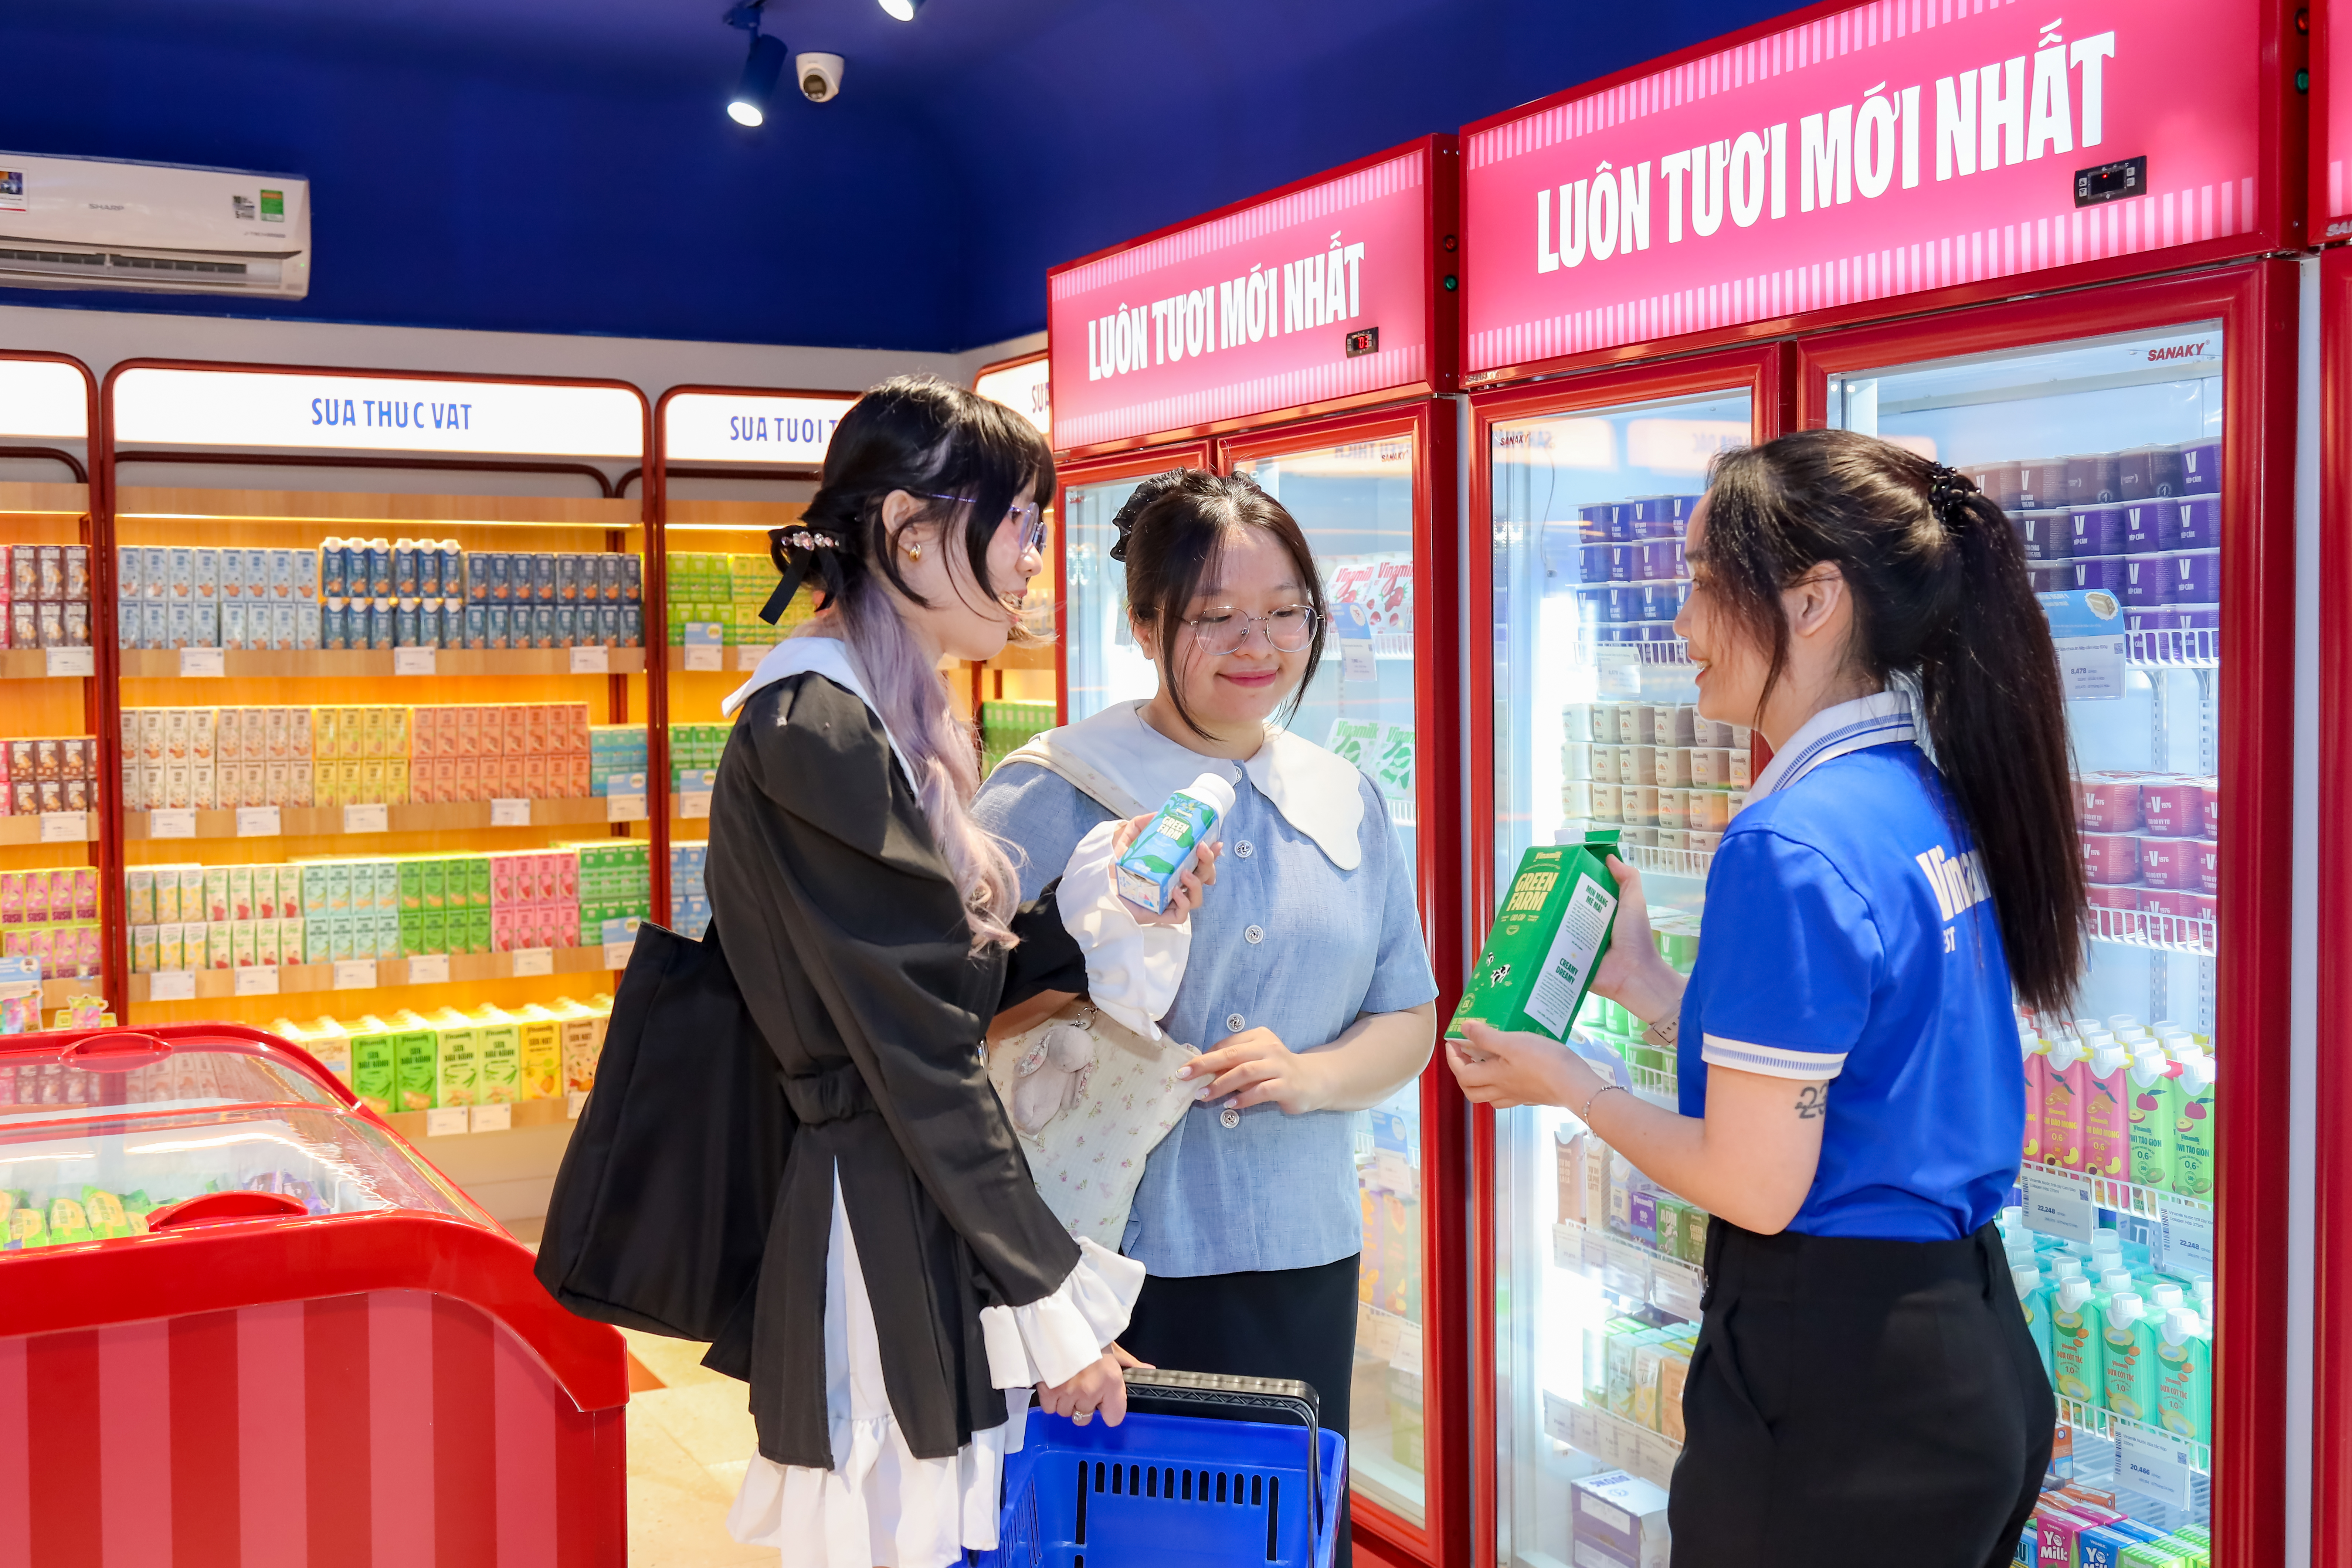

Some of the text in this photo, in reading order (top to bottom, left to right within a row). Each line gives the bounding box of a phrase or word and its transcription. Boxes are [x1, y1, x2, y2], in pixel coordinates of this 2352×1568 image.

[1537, 17, 2115, 274] LUÔN TƯƠI MỚI NHẤT
[1088, 230, 1365, 381] LUÔN TƯƠI MỚI NHẤT
[2147, 342, 2206, 362] SANAKY
[2185, 451, 2197, 474] V
[2021, 471, 2030, 491] V
[2074, 515, 2085, 535] V
[2129, 508, 2141, 530] V
[2180, 505, 2192, 528] V
[2025, 520, 2035, 541] V
[2076, 564, 2086, 586] V
[2129, 563, 2139, 584] V
[2179, 559, 2191, 580] V
[2086, 793, 2095, 808] V
[2151, 797, 2161, 813] V
[1157, 824, 1183, 841] FARM
[1162, 816, 1190, 834] GREEN
[2149, 851, 2158, 866] V
[2206, 853, 2216, 870] V
[1514, 872, 1559, 892] GREEN
[1915, 845, 1992, 922] Vinam
[1506, 891, 1549, 912] FARM
[1943, 926, 1955, 954] ST
[1555, 965, 1575, 985] DREAMY
[1559, 958, 1579, 976] CREAMY
[2137, 1151, 2149, 1160] 0,6
[2185, 1160, 2196, 1170] 0,6
[2037, 1205, 2055, 1214] 22,248
[2179, 1239, 2199, 1250] 22,248
[2130, 1463, 2150, 1475] 20,466
[2040, 1546, 2068, 1561] Milk
